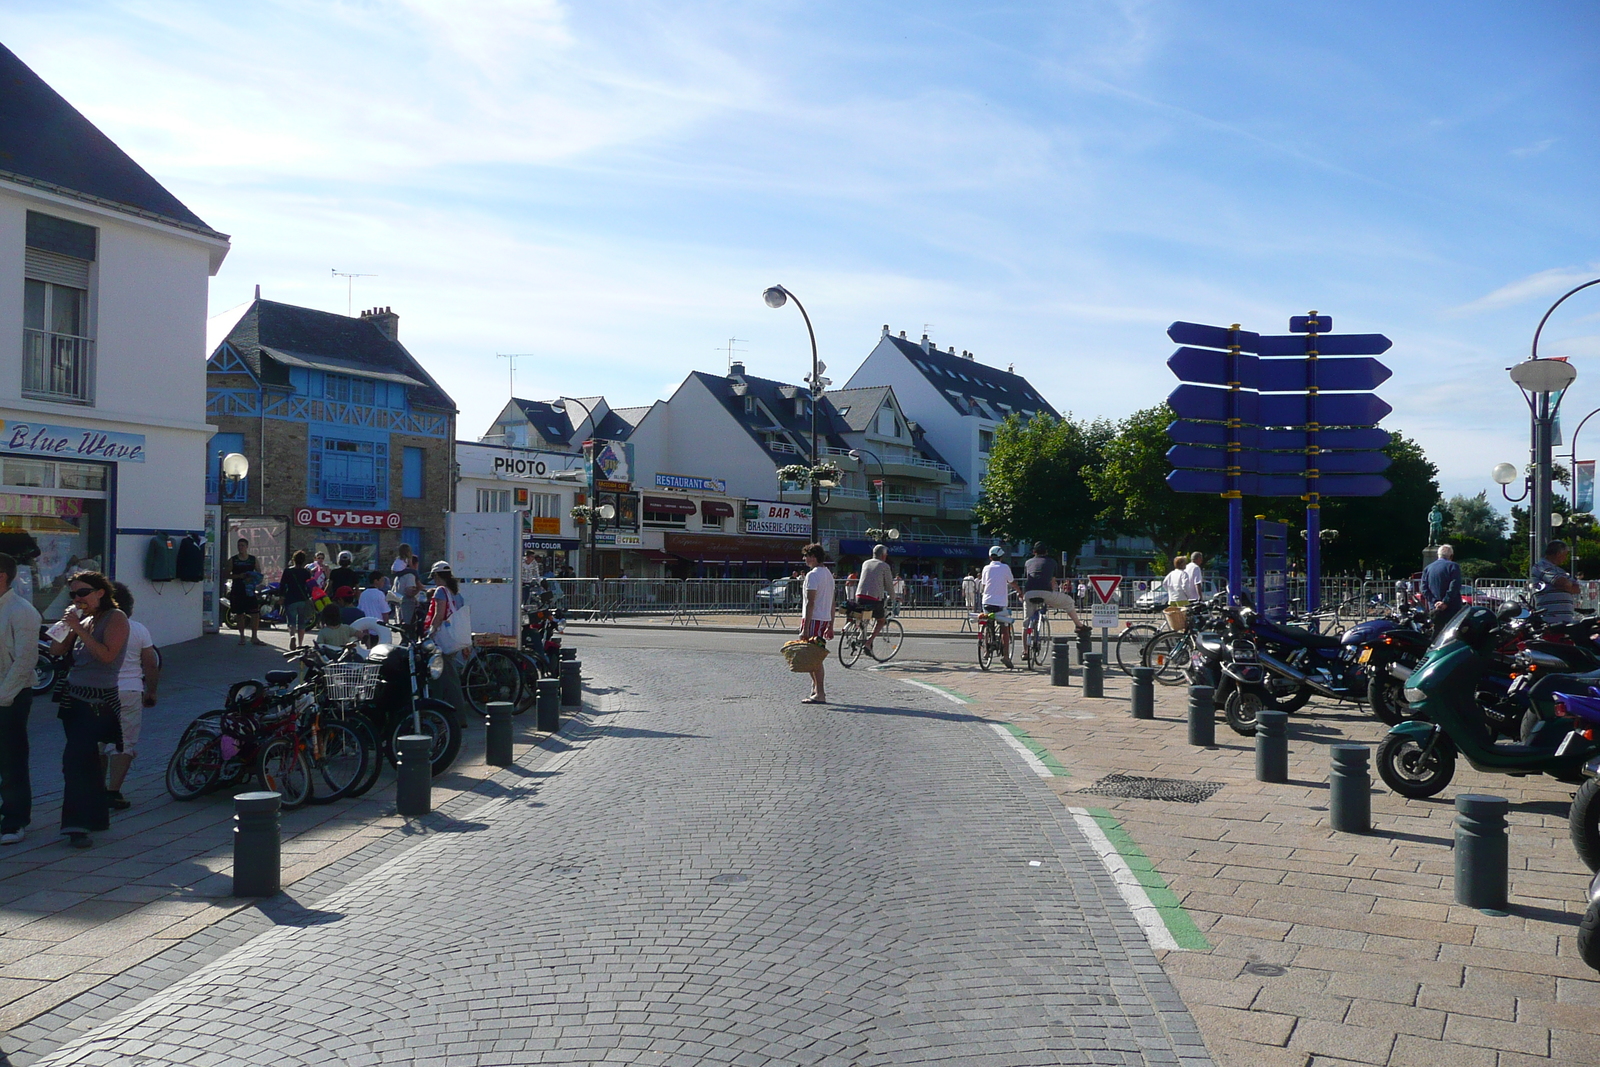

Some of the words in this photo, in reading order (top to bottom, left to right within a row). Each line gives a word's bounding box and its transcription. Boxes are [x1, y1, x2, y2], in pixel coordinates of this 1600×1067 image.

[9, 424, 68, 452] Blue
[78, 432, 142, 459] Wave
[495, 457, 546, 475] PHOTO
[656, 475, 703, 489] RESTAURANT
[316, 510, 384, 526] Cyber
[768, 506, 790, 519] BAR
[237, 526, 279, 547] SEX
[541, 542, 561, 550] COLOR
